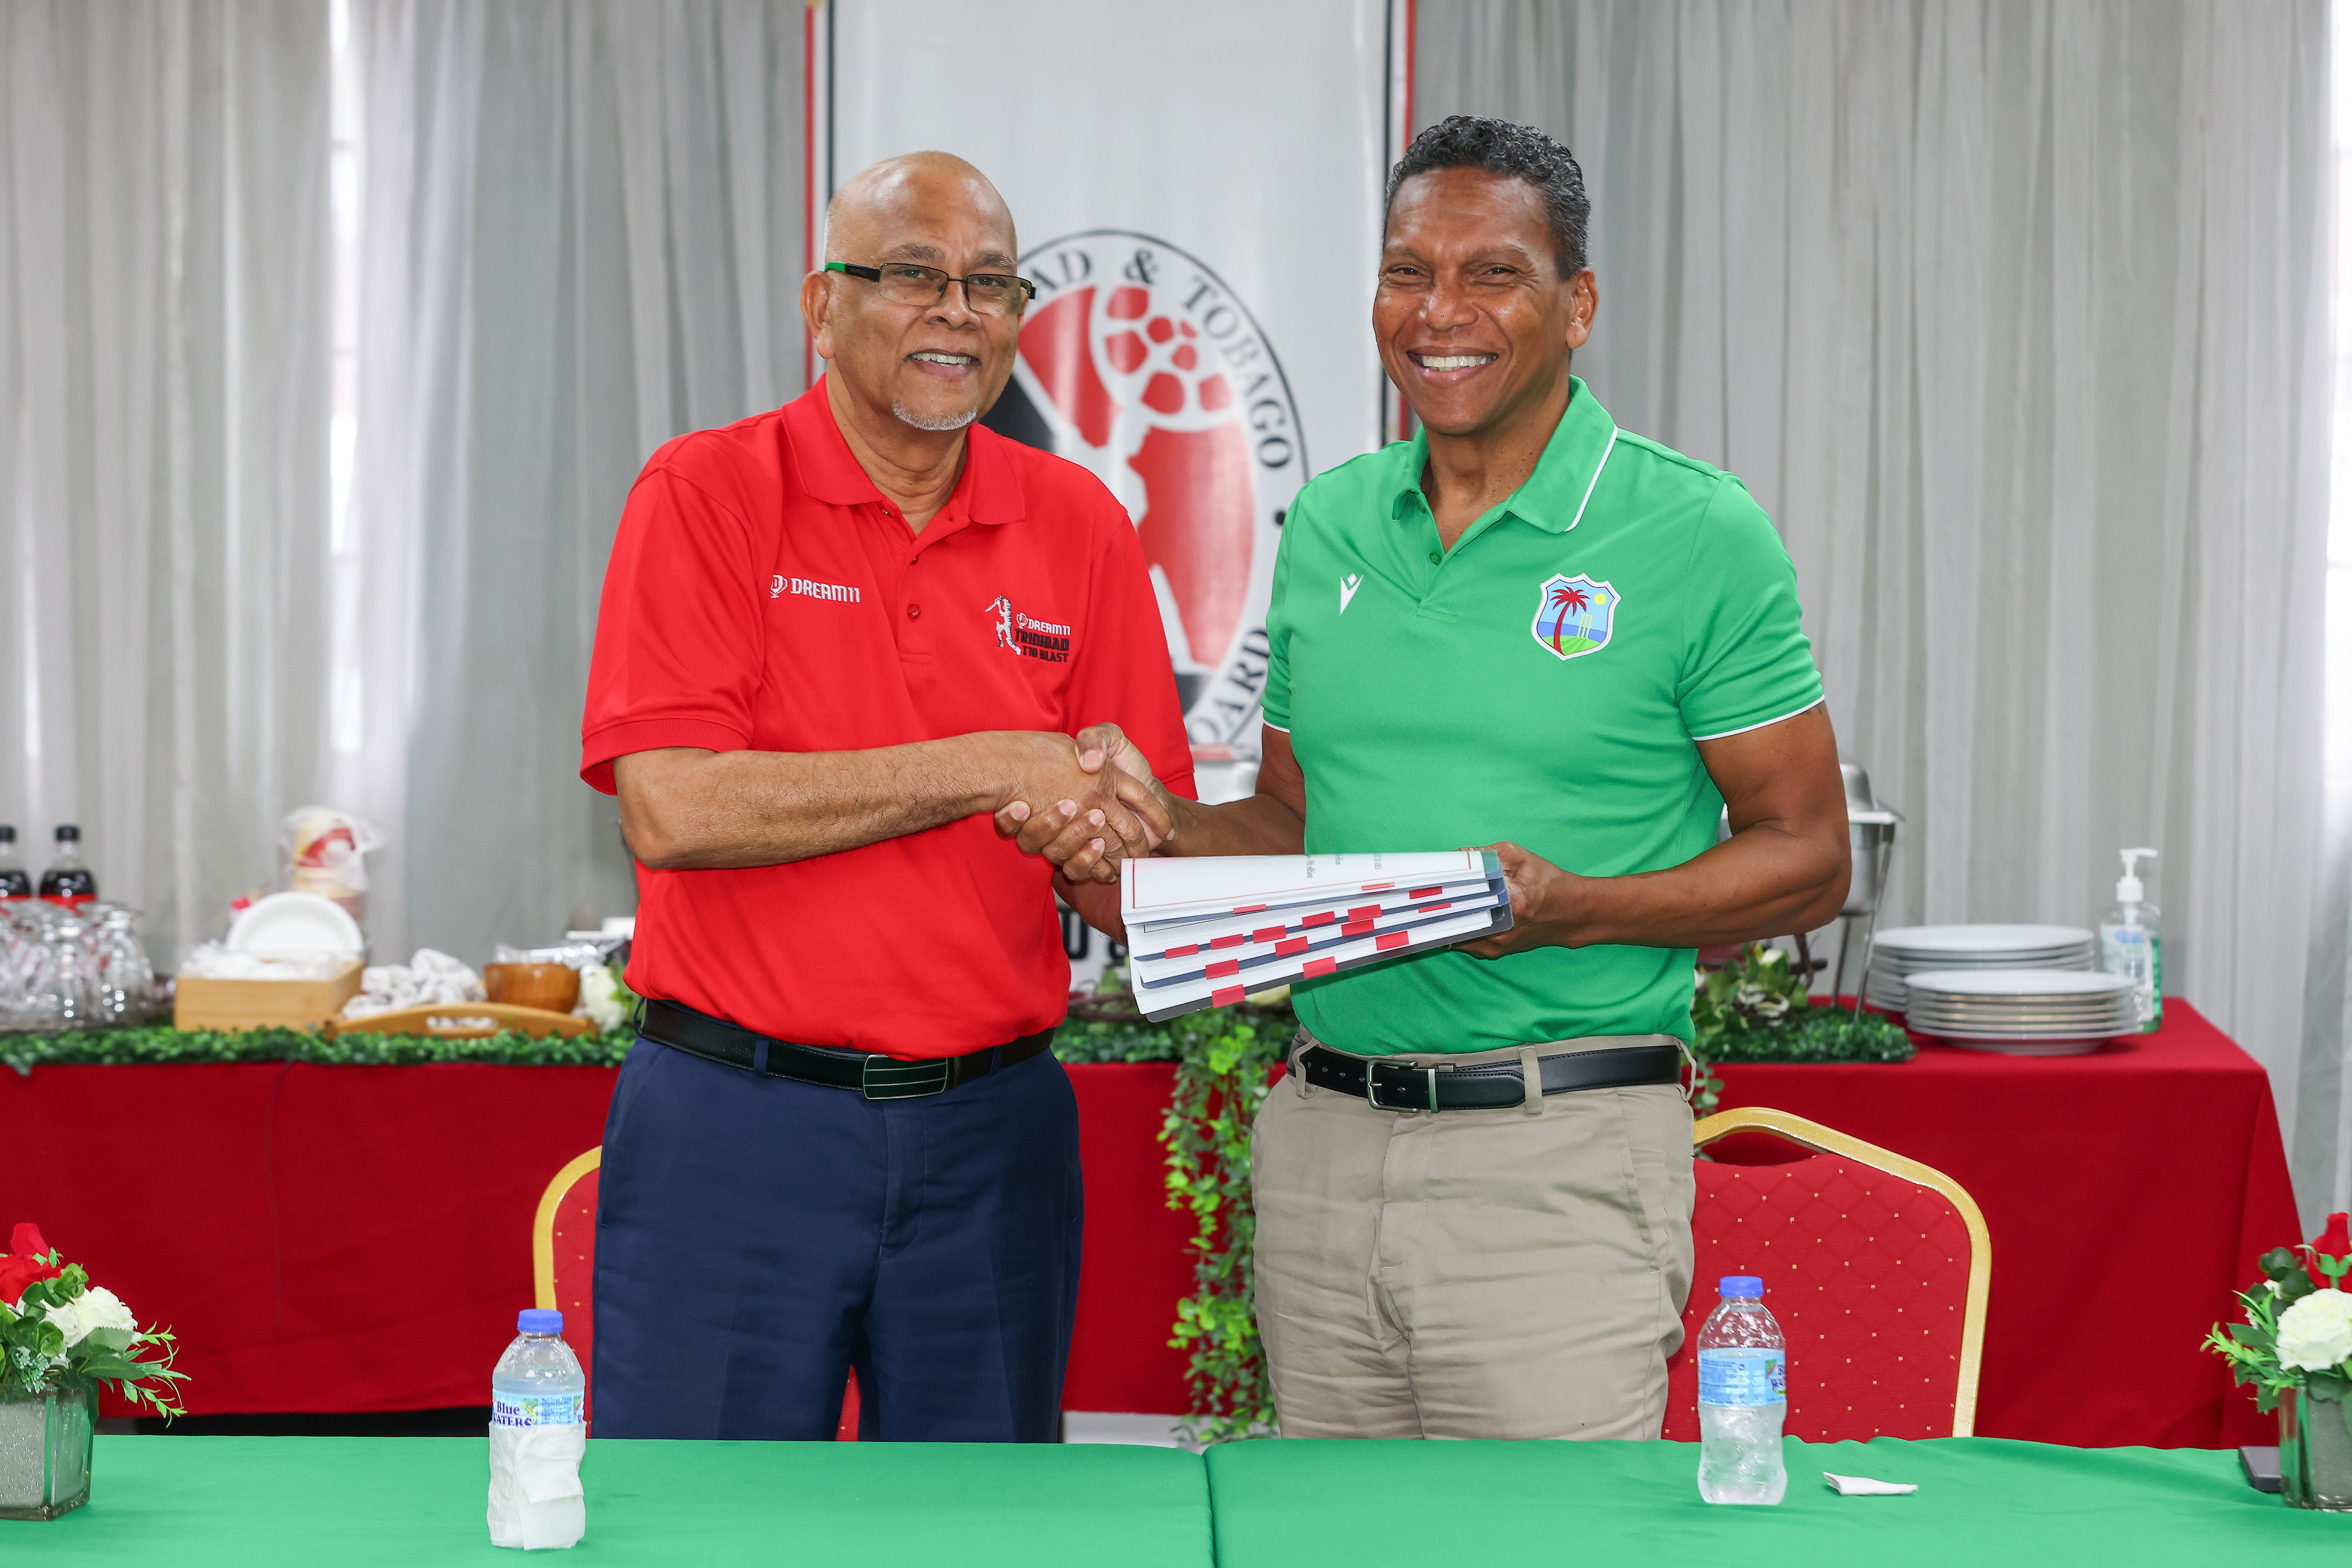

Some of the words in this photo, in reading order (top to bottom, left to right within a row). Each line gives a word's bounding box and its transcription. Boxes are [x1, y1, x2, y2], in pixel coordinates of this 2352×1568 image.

[1124, 247, 1158, 285] &
[1183, 274, 1293, 469] TOBAGO
[790, 578, 861, 603] DREAM11
[1028, 618, 1071, 635] DREAM11
[1015, 628, 1069, 651] TRINIDAD
[1022, 646, 1038, 657] T10
[1039, 649, 1069, 662] BLAST
[1188, 629, 1271, 744] OARD
[497, 1400, 520, 1415] Blue
